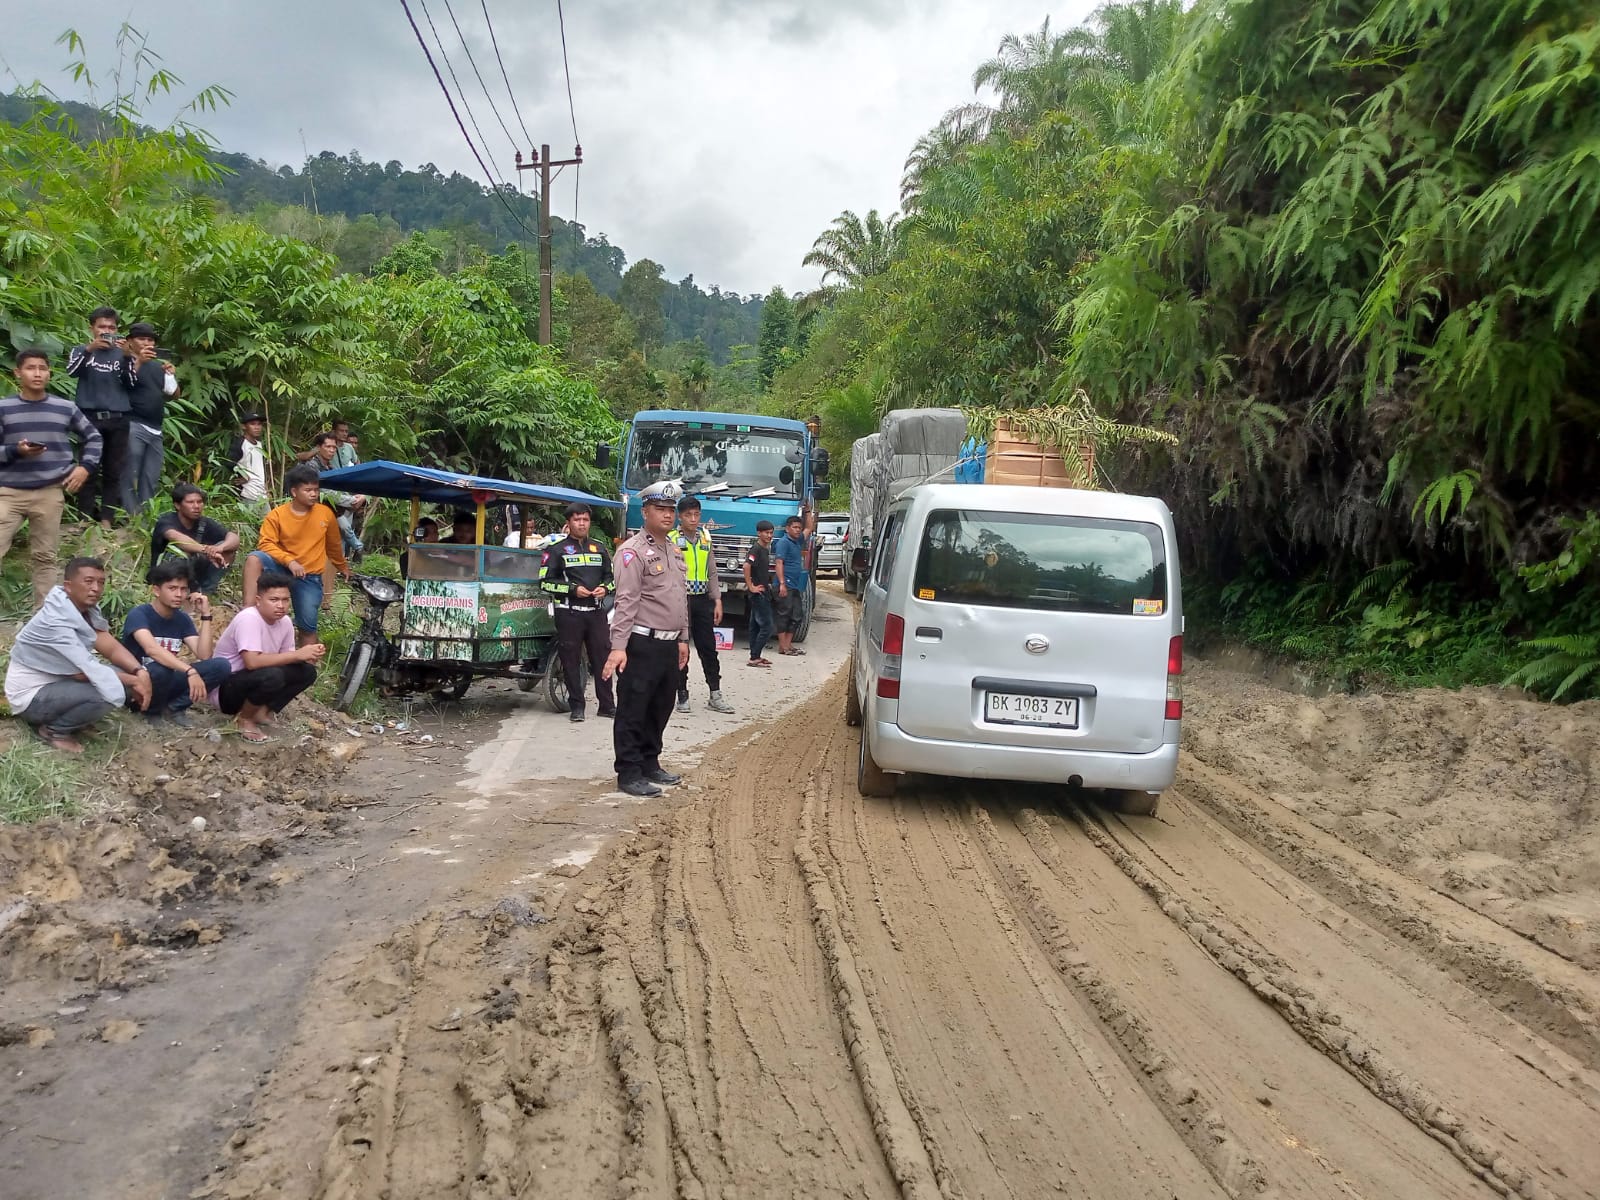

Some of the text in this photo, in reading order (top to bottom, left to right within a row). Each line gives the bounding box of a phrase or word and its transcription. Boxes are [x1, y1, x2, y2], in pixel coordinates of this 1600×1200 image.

[411, 595, 474, 608] JAGUNG MANIS
[479, 608, 487, 622] &
[993, 696, 1071, 715] BK 1983 ZY
